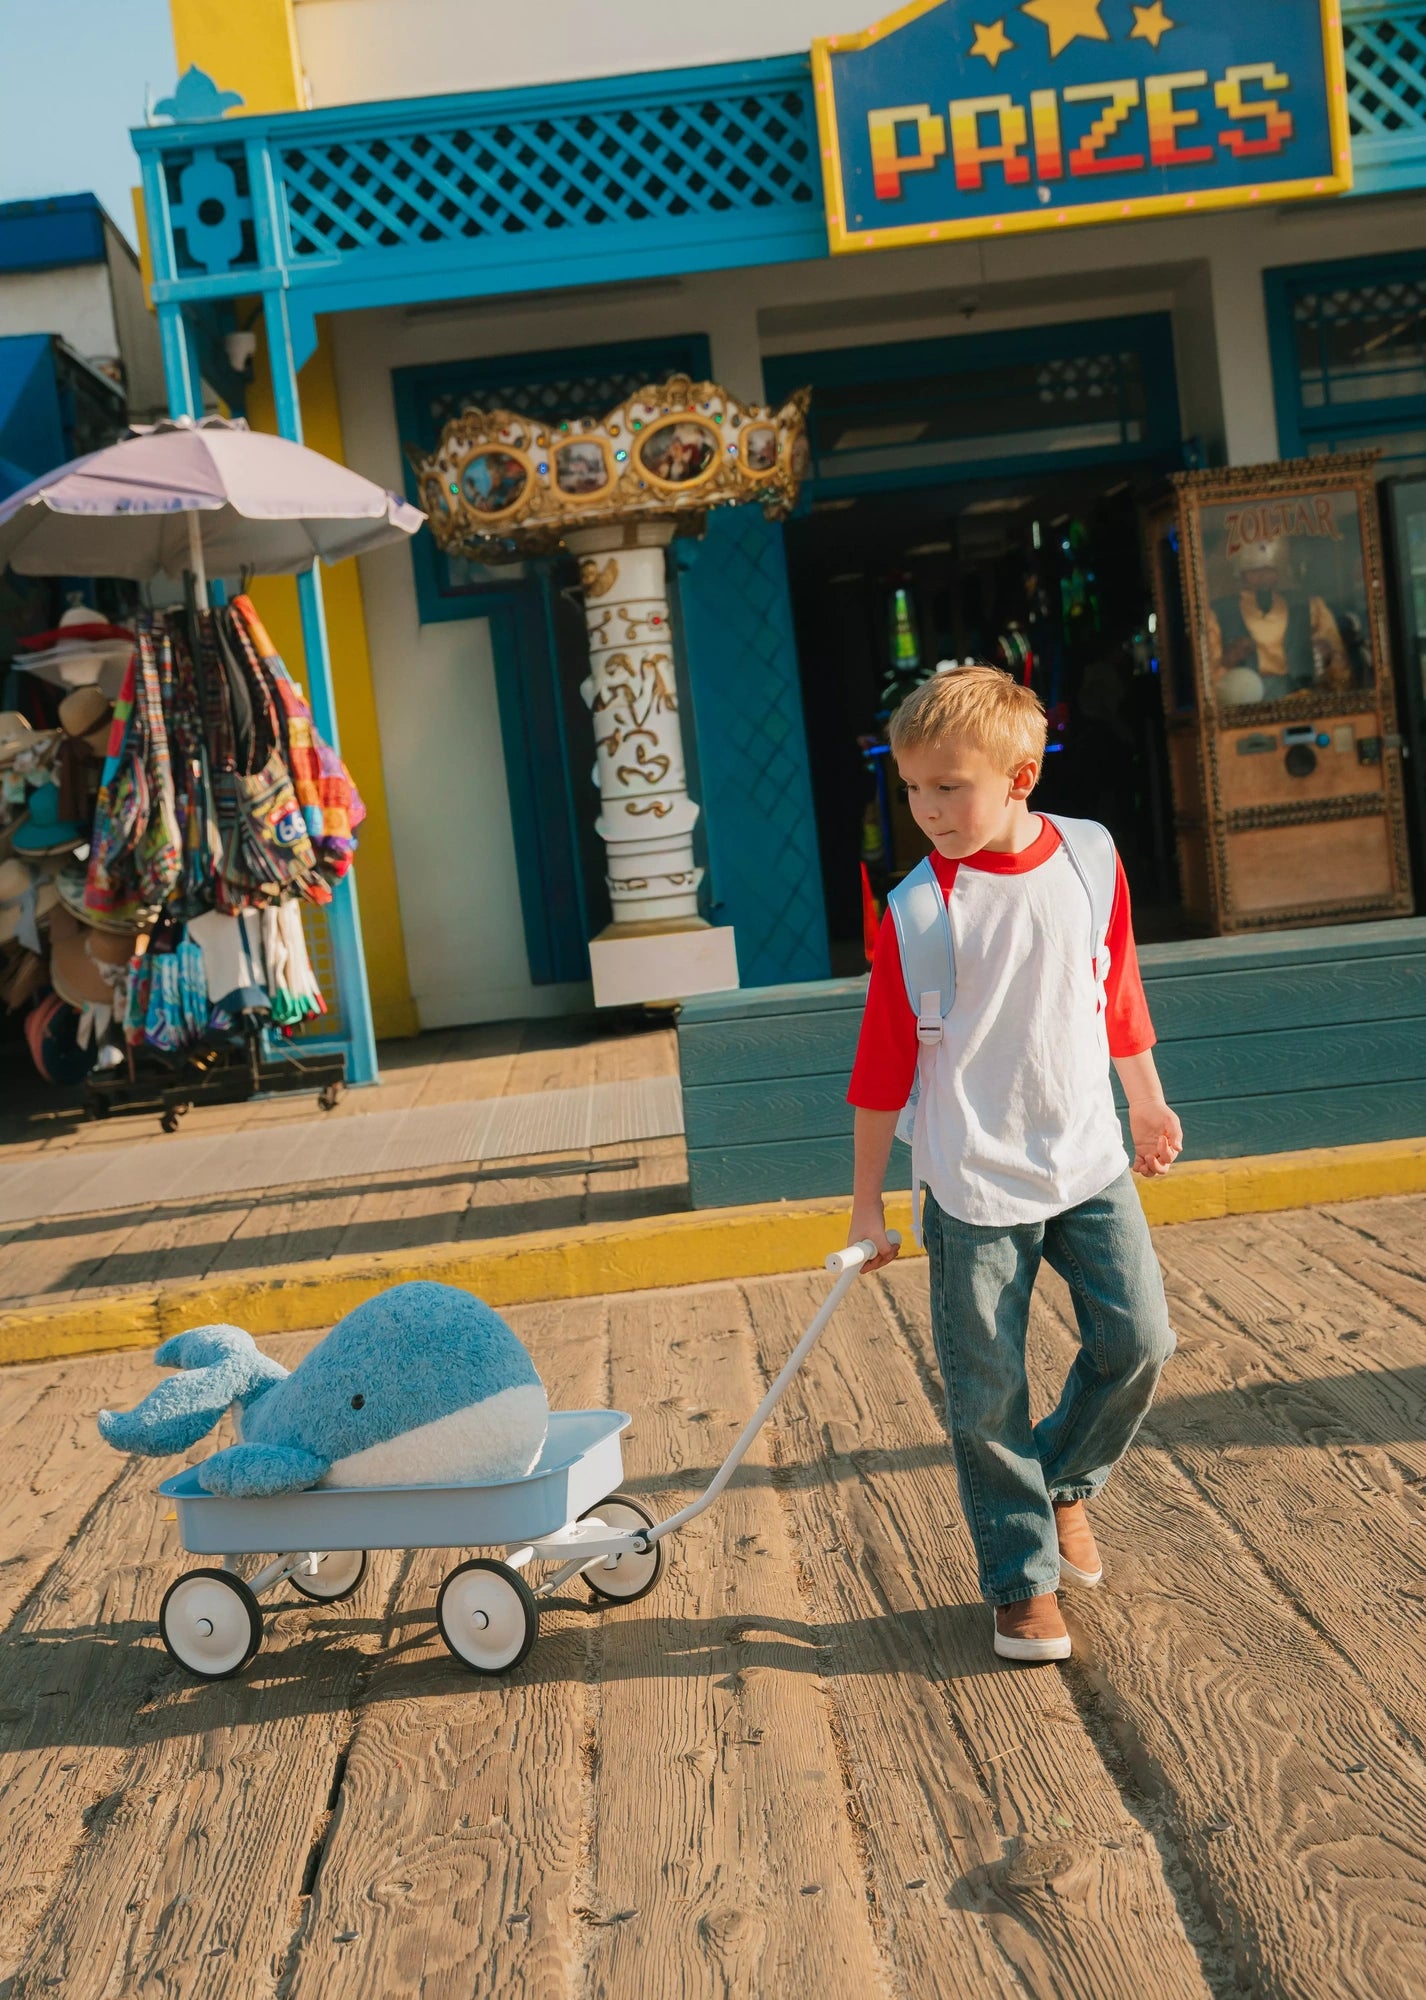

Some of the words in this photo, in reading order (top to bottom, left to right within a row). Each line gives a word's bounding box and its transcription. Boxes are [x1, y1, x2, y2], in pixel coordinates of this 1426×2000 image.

[867, 62, 1292, 199] PRIZES
[1224, 496, 1343, 559] ZOLTAR
[279, 810, 307, 842] 66
